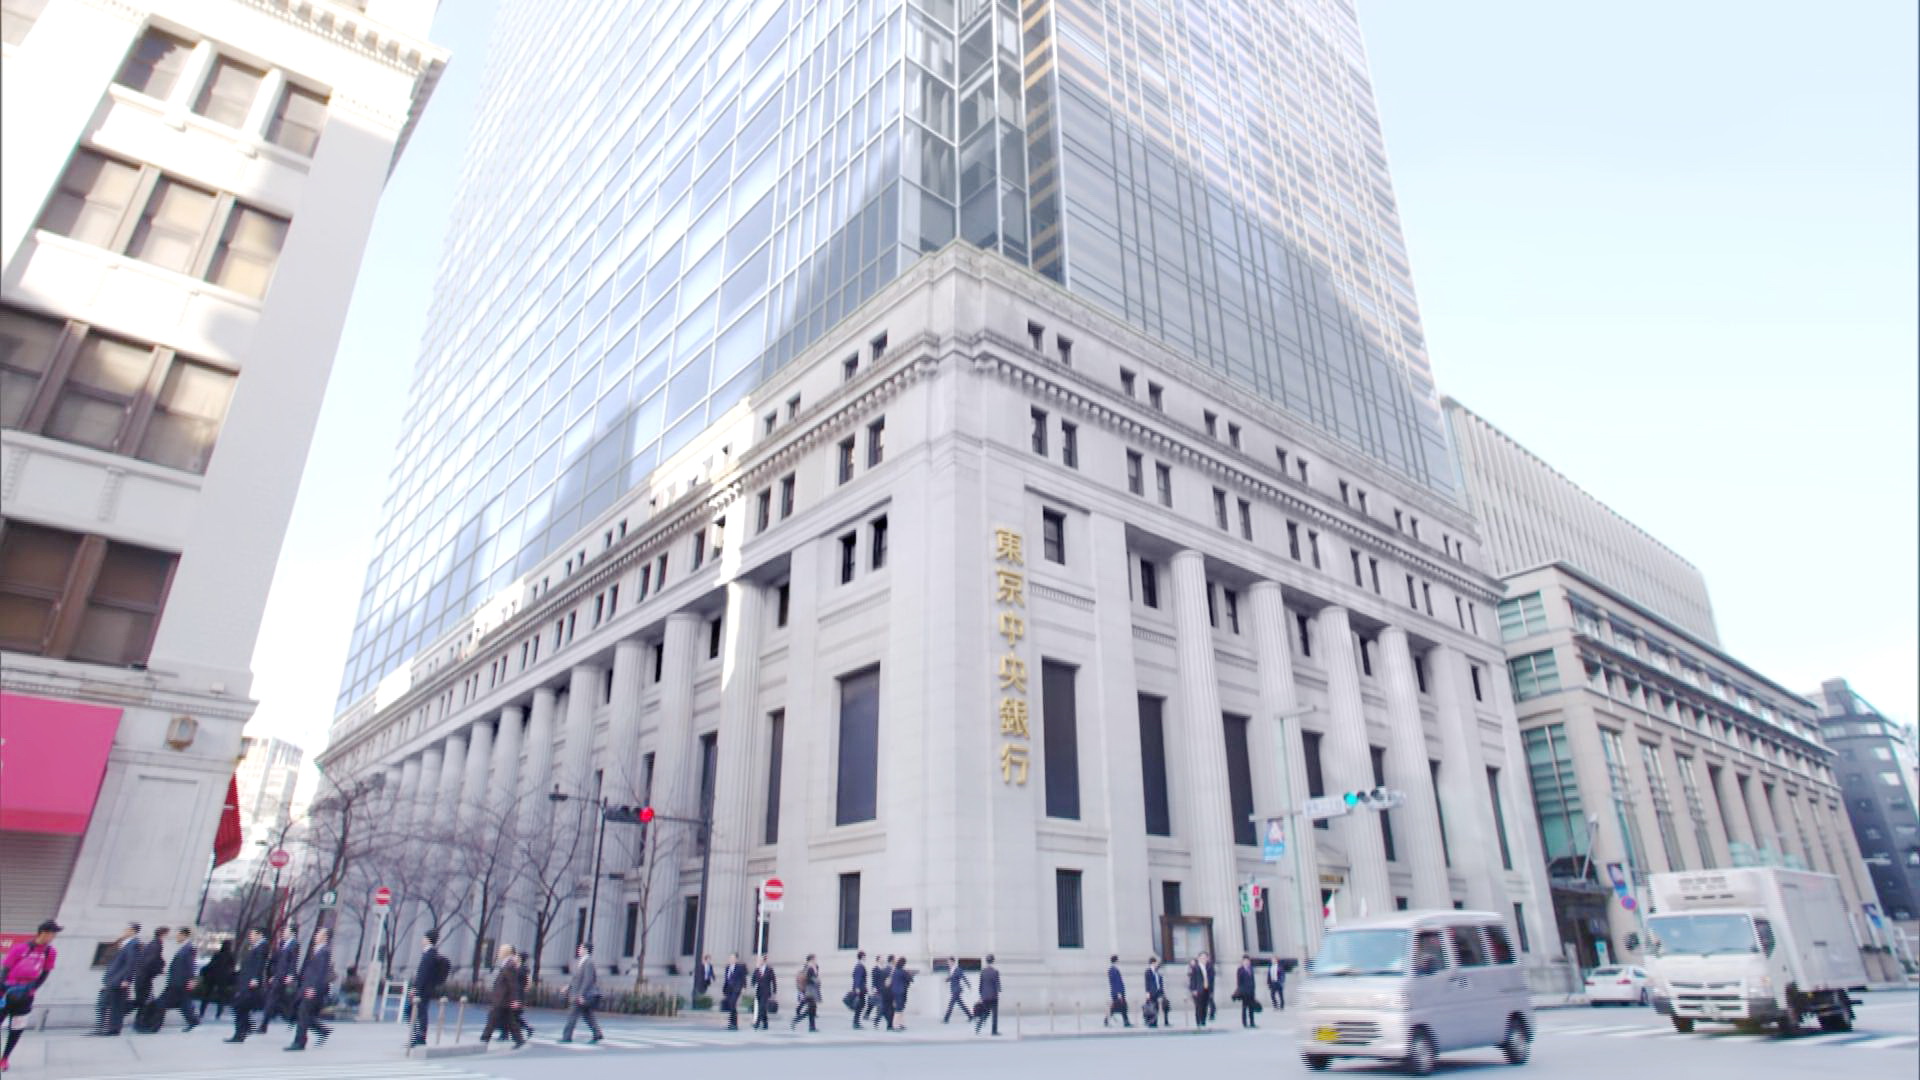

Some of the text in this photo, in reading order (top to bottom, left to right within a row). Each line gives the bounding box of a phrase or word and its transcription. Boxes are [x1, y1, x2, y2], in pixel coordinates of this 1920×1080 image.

[995, 527, 1030, 785] 東京中央銀行
